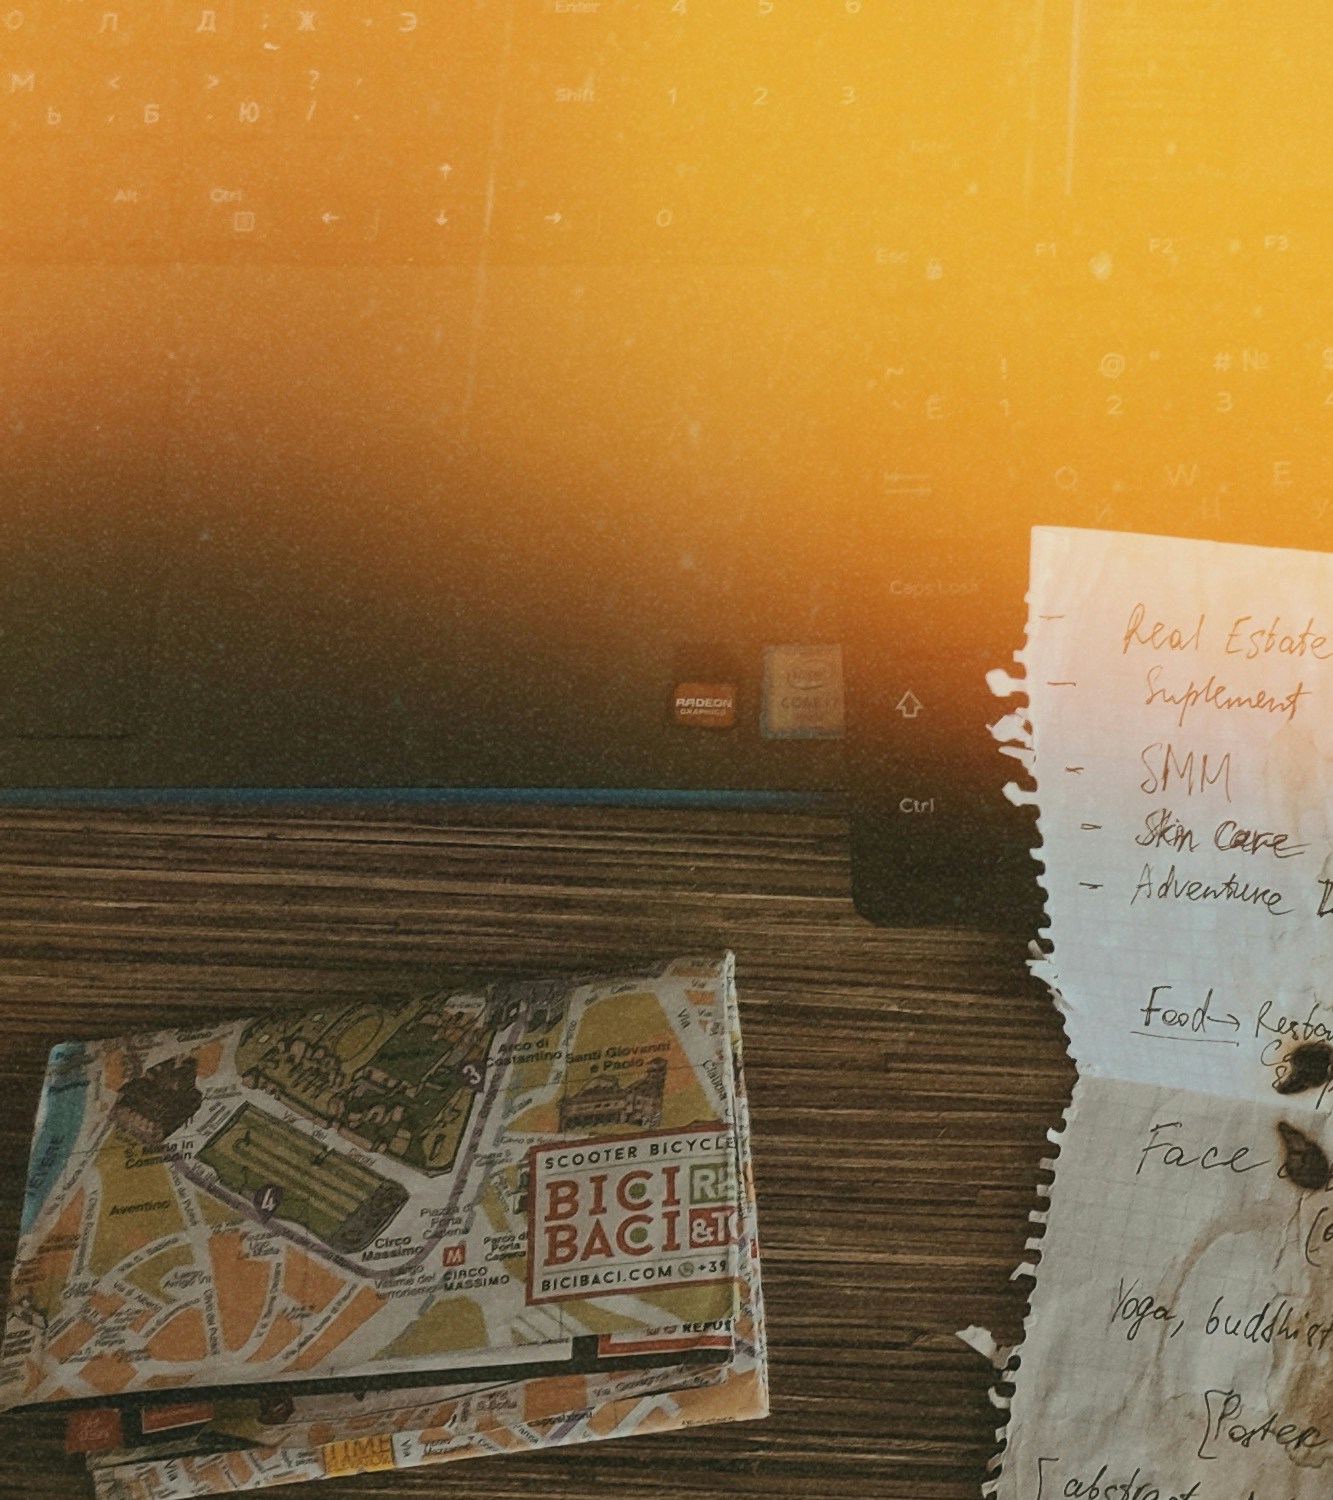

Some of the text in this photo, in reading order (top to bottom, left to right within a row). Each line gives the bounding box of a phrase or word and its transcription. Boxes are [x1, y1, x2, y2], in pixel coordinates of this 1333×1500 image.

[1123, 604, 1200, 655] Real
[675, 697, 733, 709] RADEON
[1139, 743, 1232, 801] SMM
[900, 798, 935, 814] Ctrl
[1135, 809, 1308, 860] Skin Care
[1130, 865, 1295, 917] Adventure
[1140, 984, 1210, 1030] Food
[544, 1145, 638, 1170] SCOOTER
[649, 1135, 738, 1156] BICYCLE
[1135, 1120, 1273, 1176] Face
[544, 1165, 681, 1222] BICI
[374, 1235, 412, 1250] Circo
[543, 1210, 681, 1267] BACI
[442, 1266, 488, 1282] CIRCO
[443, 1274, 510, 1292] MASSIMO
[541, 1264, 673, 1292] BICIBACI.COM
